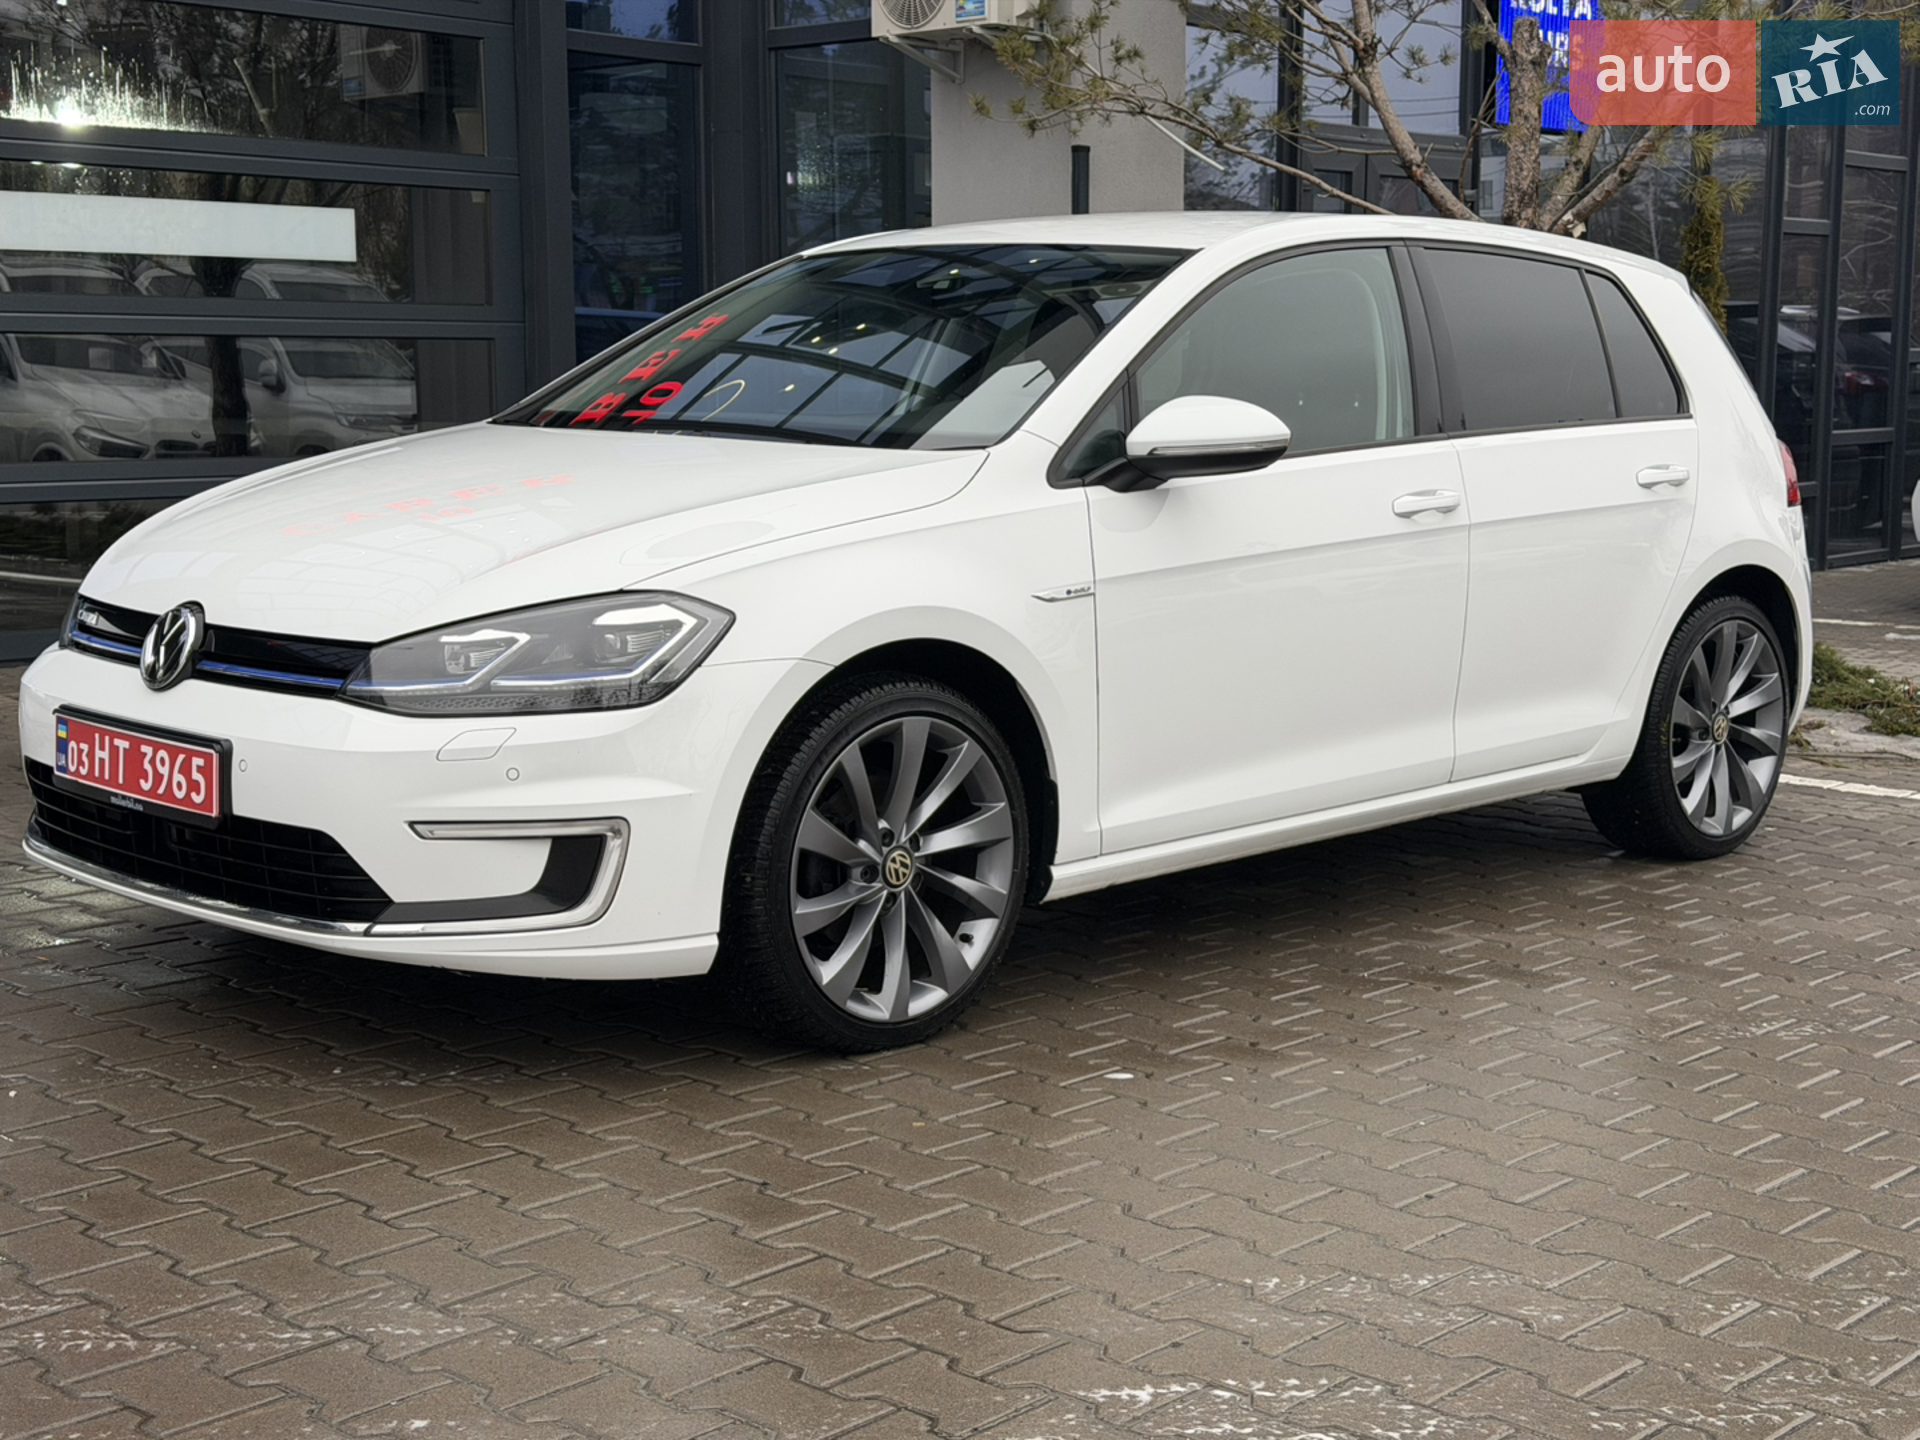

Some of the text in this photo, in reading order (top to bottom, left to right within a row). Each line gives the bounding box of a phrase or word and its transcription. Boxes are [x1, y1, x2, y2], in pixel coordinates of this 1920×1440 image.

[68, 733, 206, 804] 03 HT 3965
